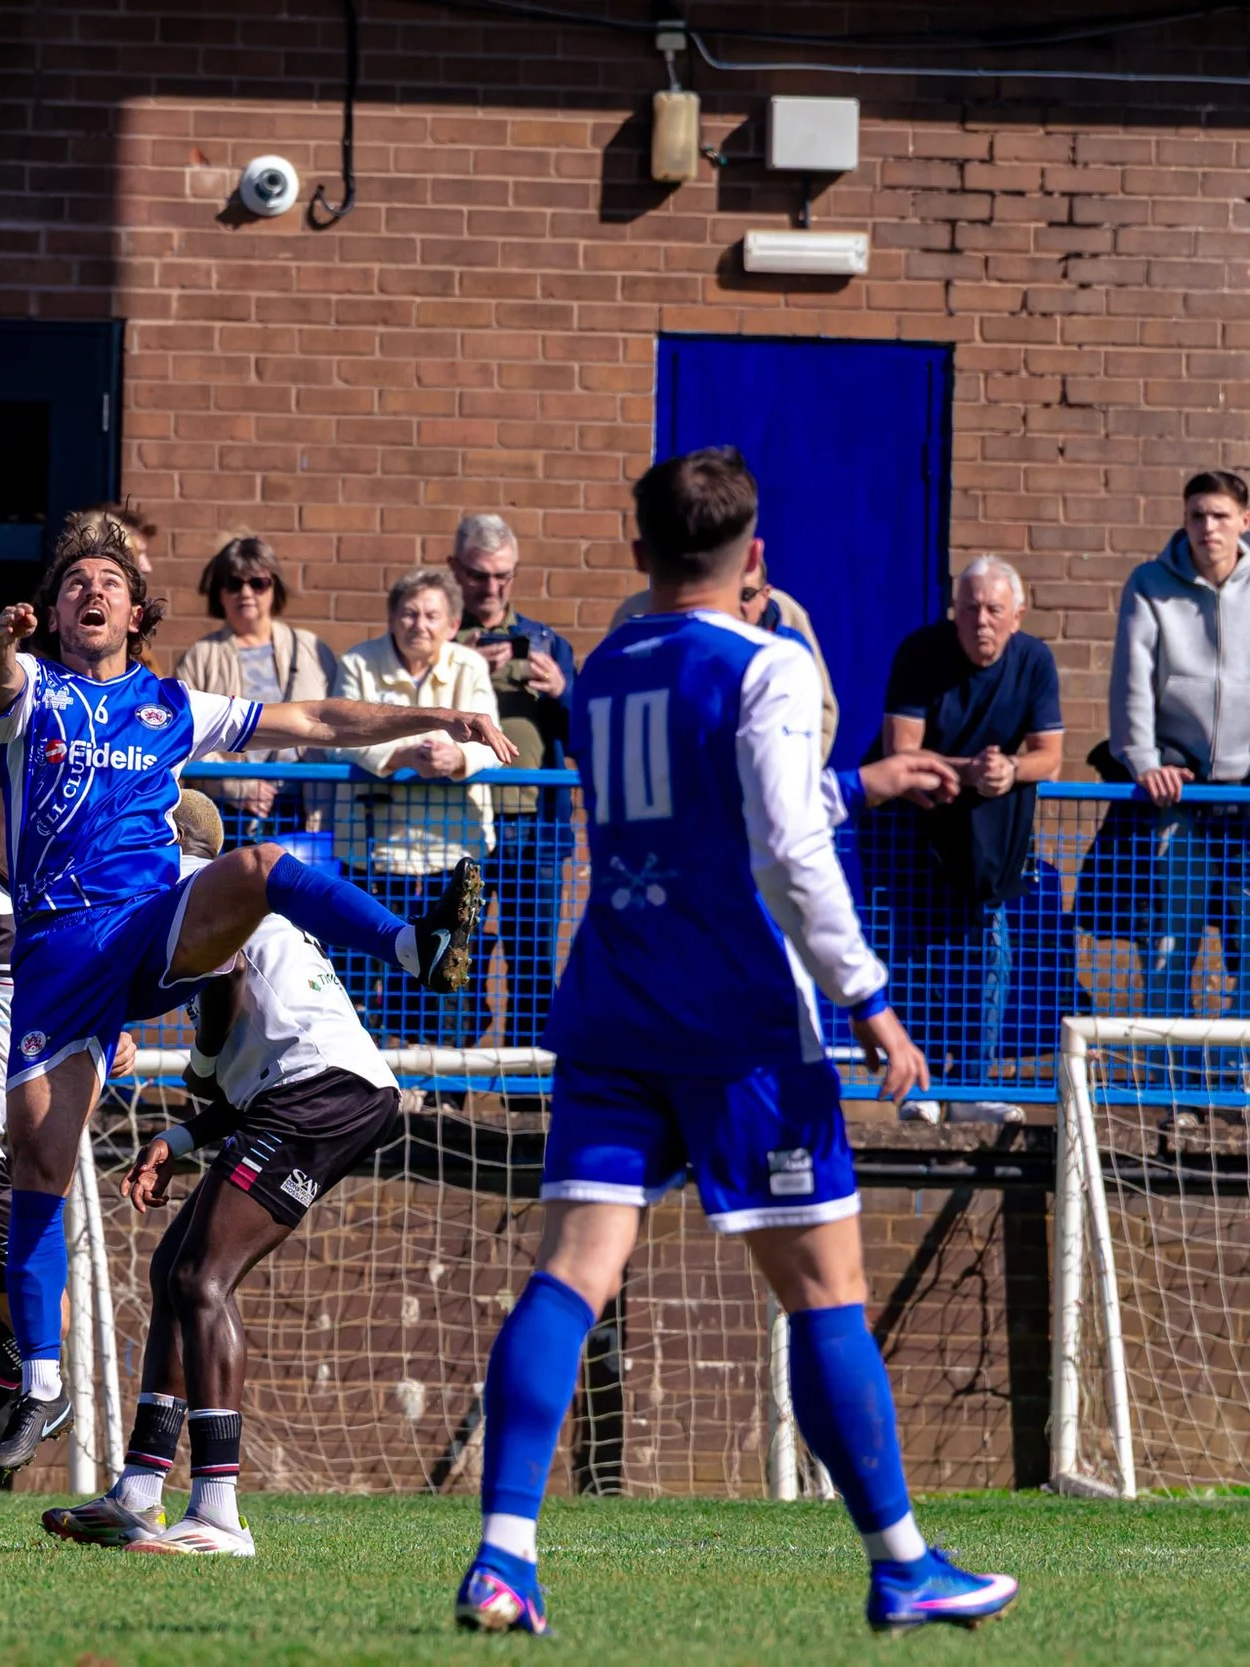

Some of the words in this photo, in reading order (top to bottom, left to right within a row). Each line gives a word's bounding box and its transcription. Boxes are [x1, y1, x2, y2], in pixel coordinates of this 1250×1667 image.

[94, 694, 109, 724] 6
[69, 739, 158, 771] Fidelis
[588, 688, 672, 824] 10
